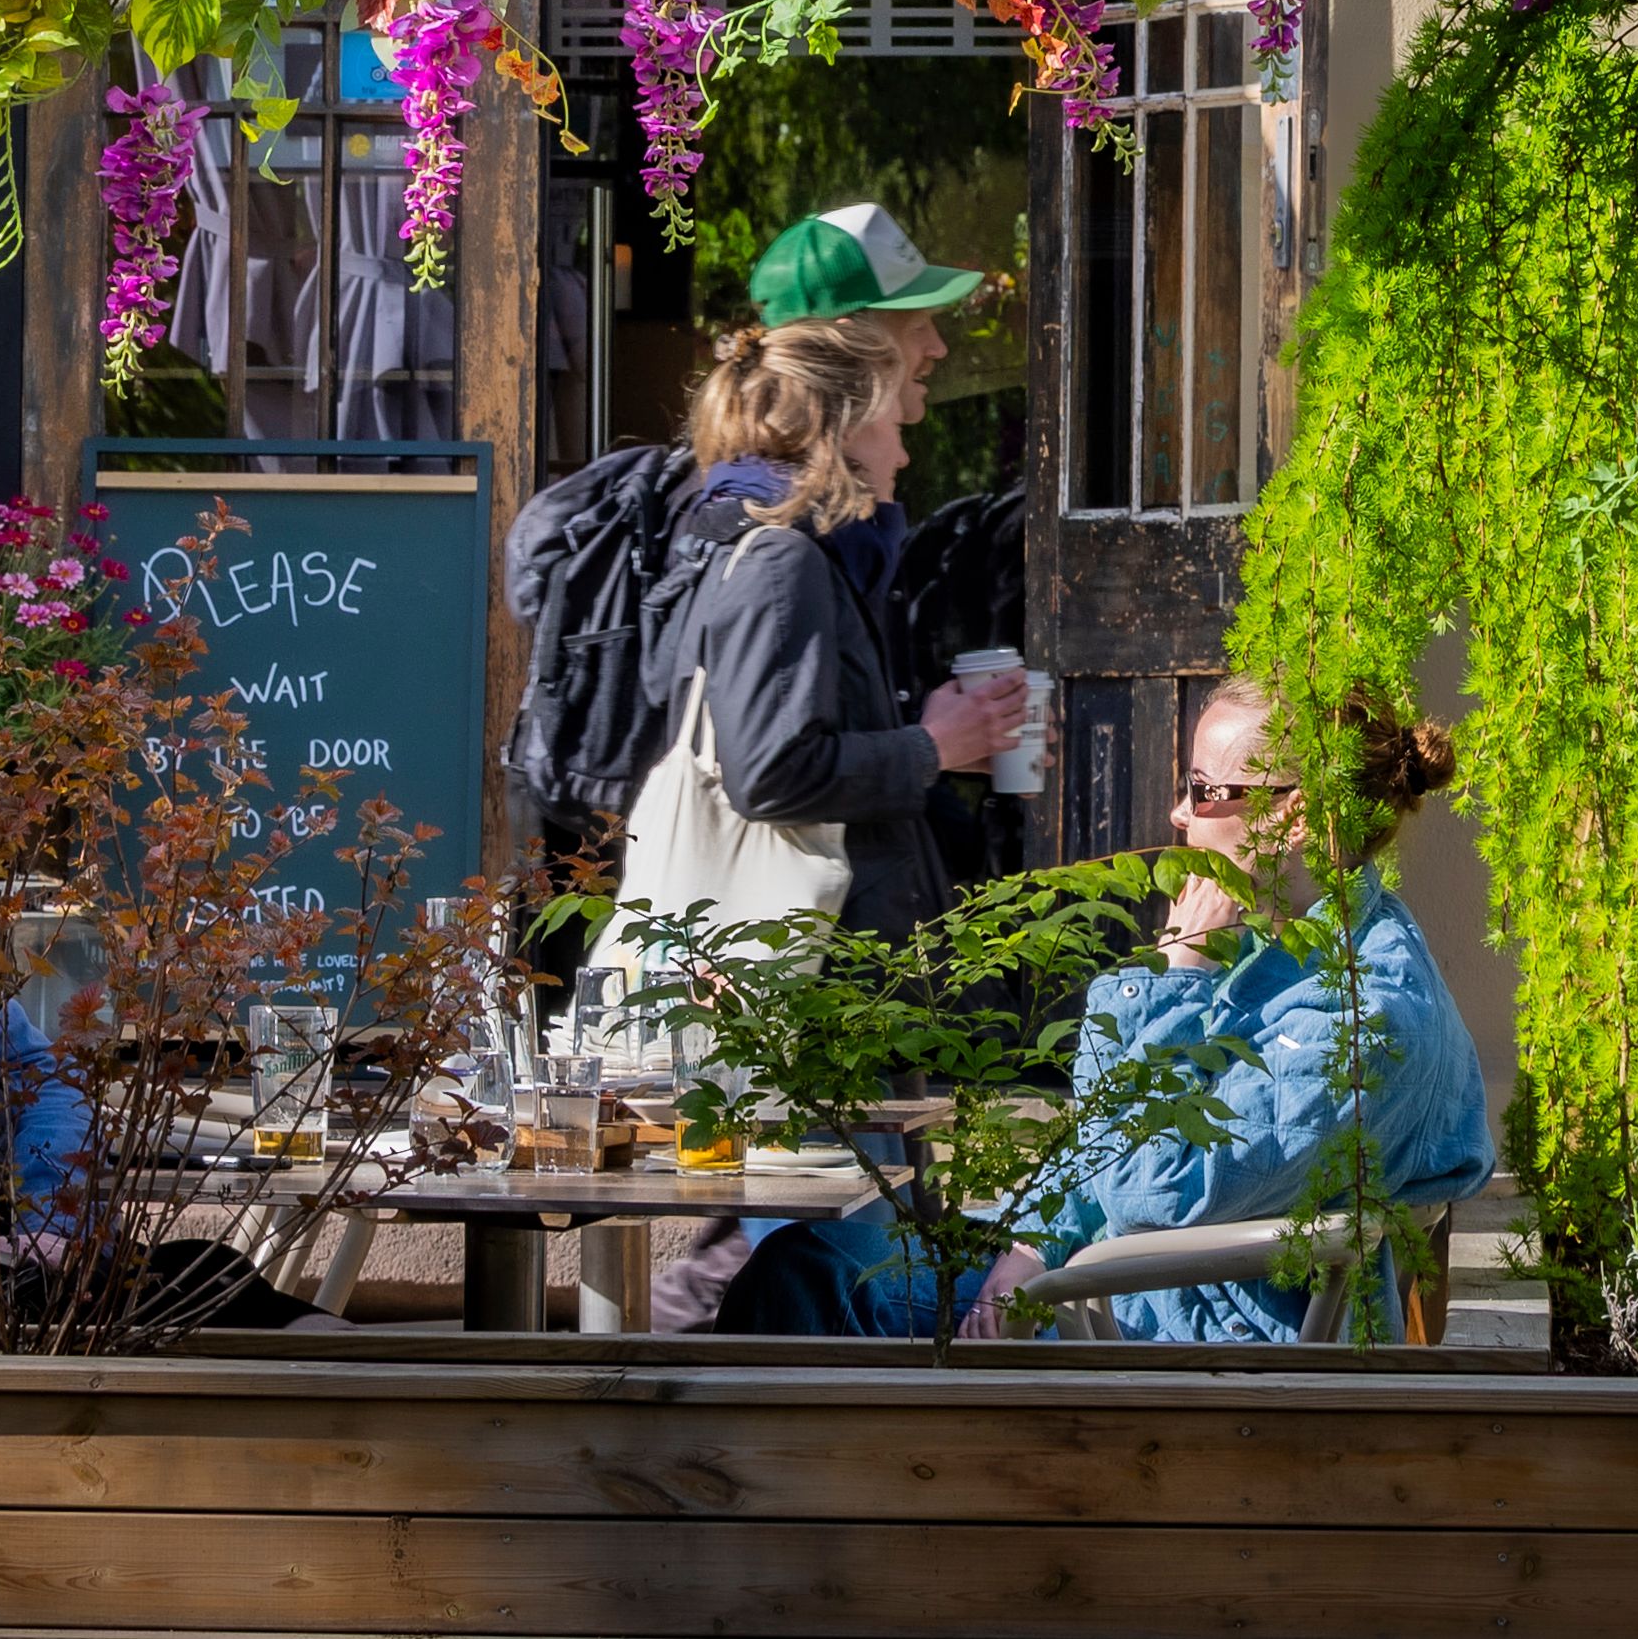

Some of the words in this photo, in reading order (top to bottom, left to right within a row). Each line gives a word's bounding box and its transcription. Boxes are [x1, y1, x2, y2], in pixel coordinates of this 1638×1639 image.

[142, 547, 377, 627] PLEASE
[230, 662, 329, 709] WAIT
[309, 738, 392, 771] DOOR
